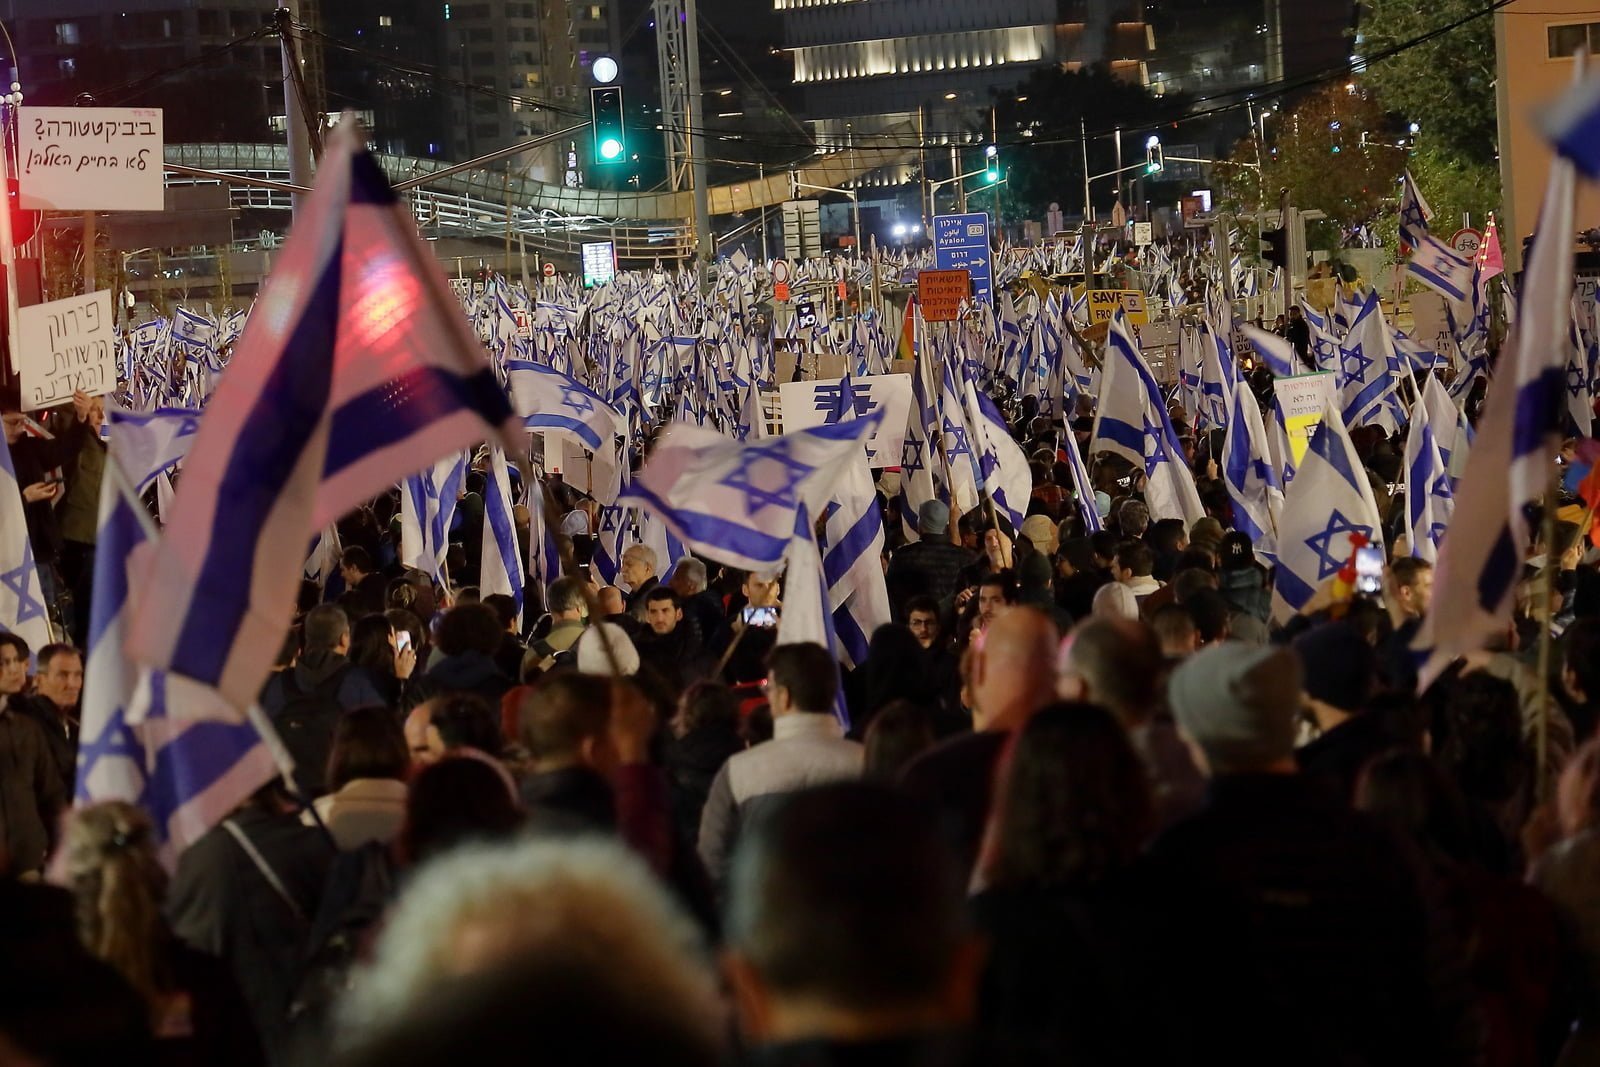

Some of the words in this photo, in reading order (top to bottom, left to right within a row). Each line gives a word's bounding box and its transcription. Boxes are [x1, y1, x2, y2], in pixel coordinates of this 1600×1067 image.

[35, 118, 156, 143] ביביקטטורה?
[26, 144, 71, 174] האלה!
[76, 156, 118, 172] בחיים
[126, 149, 150, 171] לא
[940, 219, 962, 229] איילון
[970, 226, 981, 234] 20
[939, 237, 965, 245] Ayalon
[951, 250, 968, 259] דרום
[925, 275, 962, 285] משאיות
[926, 286, 962, 296] מאיטות
[1092, 291, 1122, 304] SAVE
[1096, 309, 1113, 320] FRO
[48, 301, 100, 352] פירוק
[45, 340, 108, 376] הרשויות
[34, 364, 104, 402] והמדינה
[1293, 395, 1304, 403] לא
[1306, 393, 1316, 401] זה
